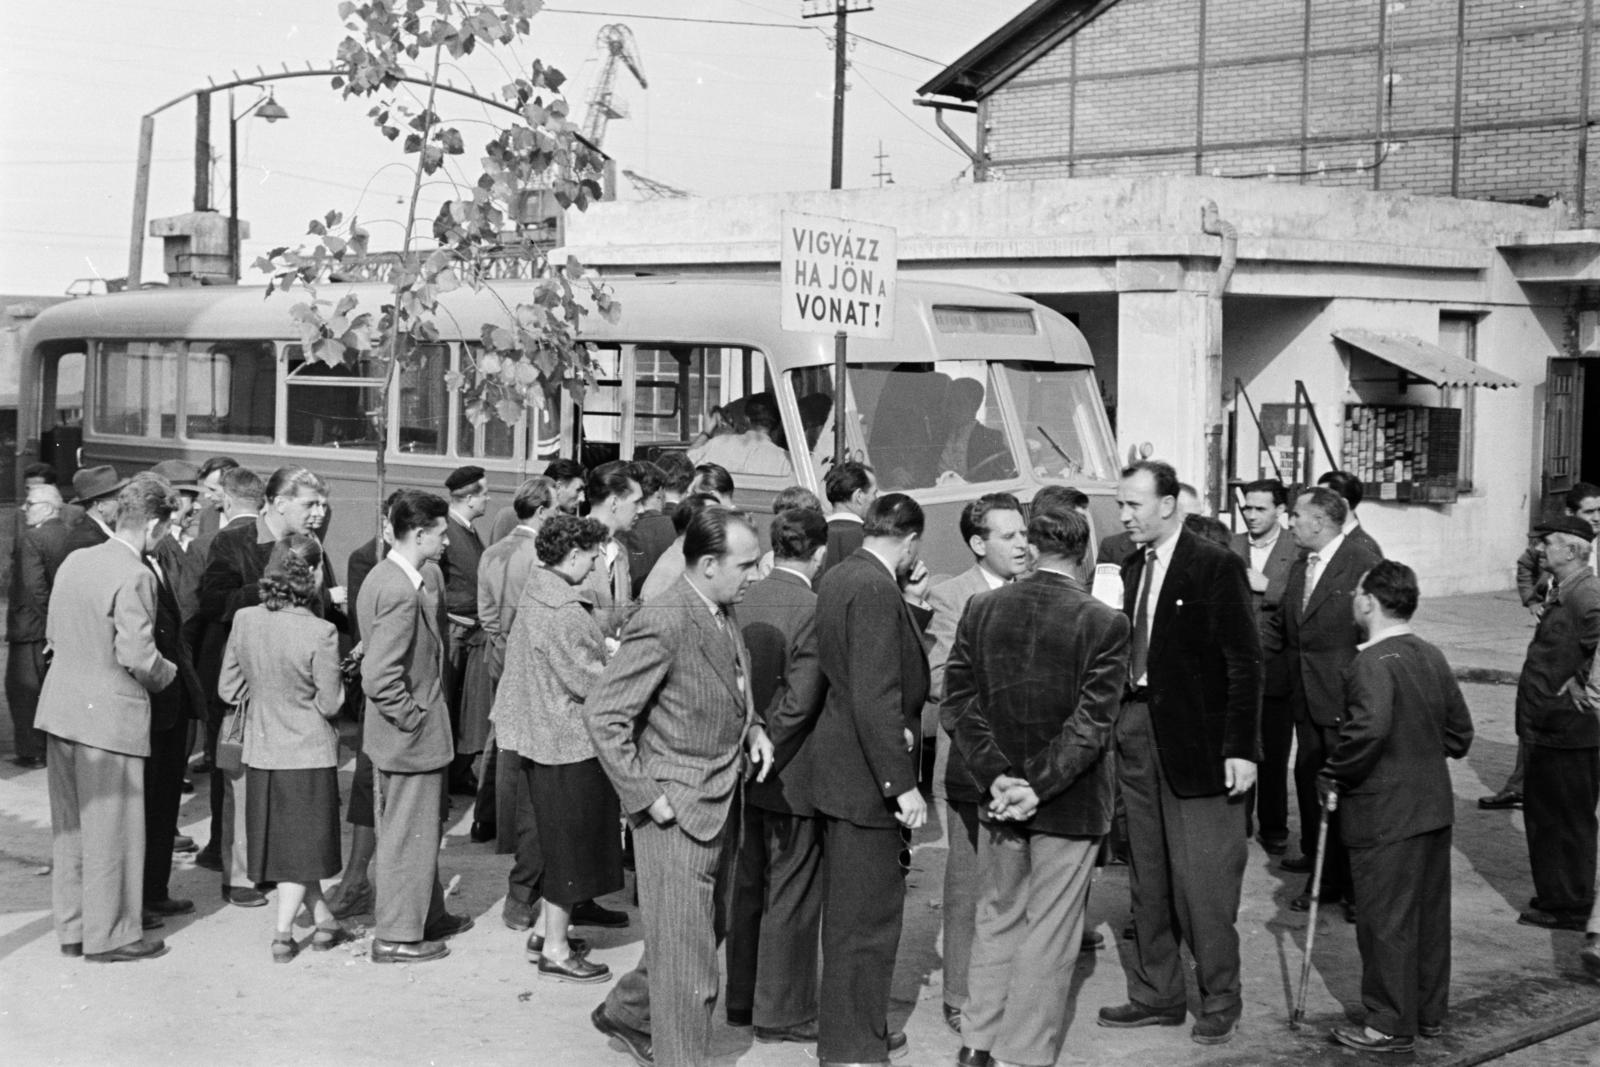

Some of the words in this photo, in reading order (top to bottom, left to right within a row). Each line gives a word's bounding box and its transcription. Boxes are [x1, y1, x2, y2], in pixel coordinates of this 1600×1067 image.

[792, 227, 879, 262] VIGYÁZZ
[795, 259, 822, 289] HA
[828, 260, 873, 296] JÖN
[878, 279, 887, 298] A
[796, 292, 881, 328] VONAT!
